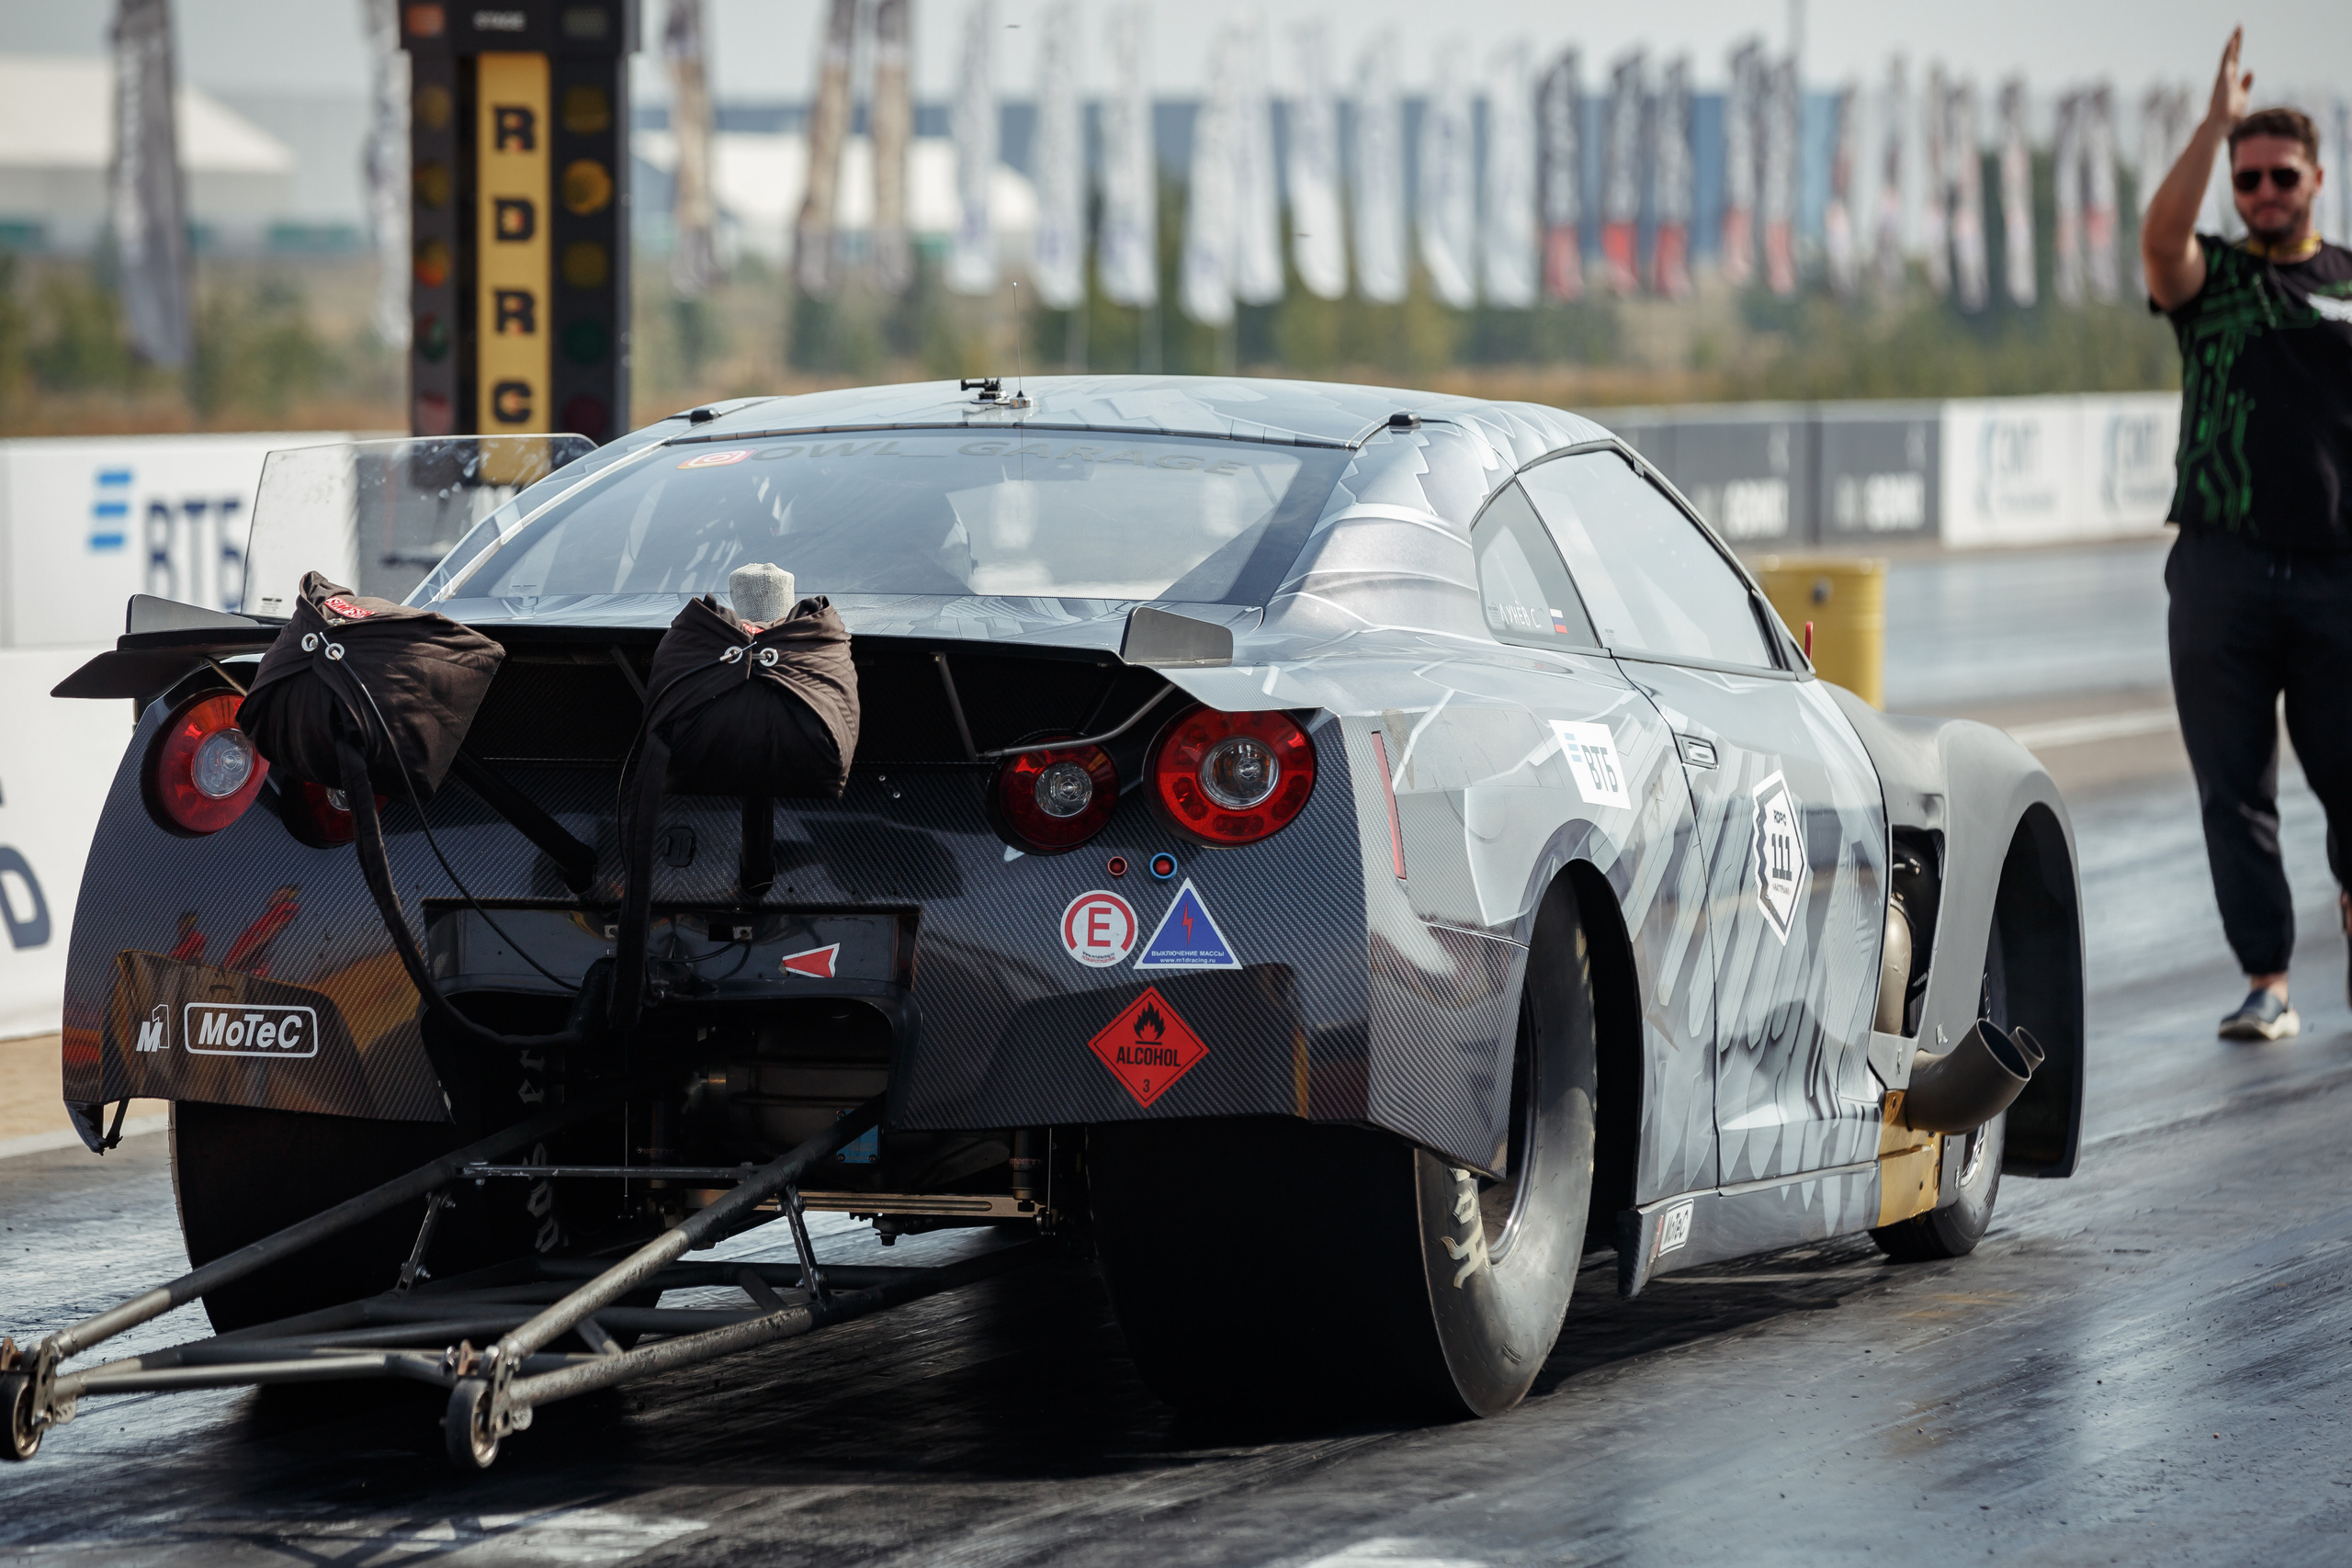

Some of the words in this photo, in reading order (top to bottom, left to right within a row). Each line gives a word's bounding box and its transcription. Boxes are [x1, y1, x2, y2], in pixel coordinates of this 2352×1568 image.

[492, 104, 537, 424] RDRC
[1580, 744, 1619, 793] ВТБ
[1771, 833, 1792, 882] 111
[1087, 907, 1112, 947] E
[198, 1012, 302, 1049] MoTeC
[1115, 1045, 1182, 1067] ALCOHOL
[1142, 1078, 1150, 1093] 3
